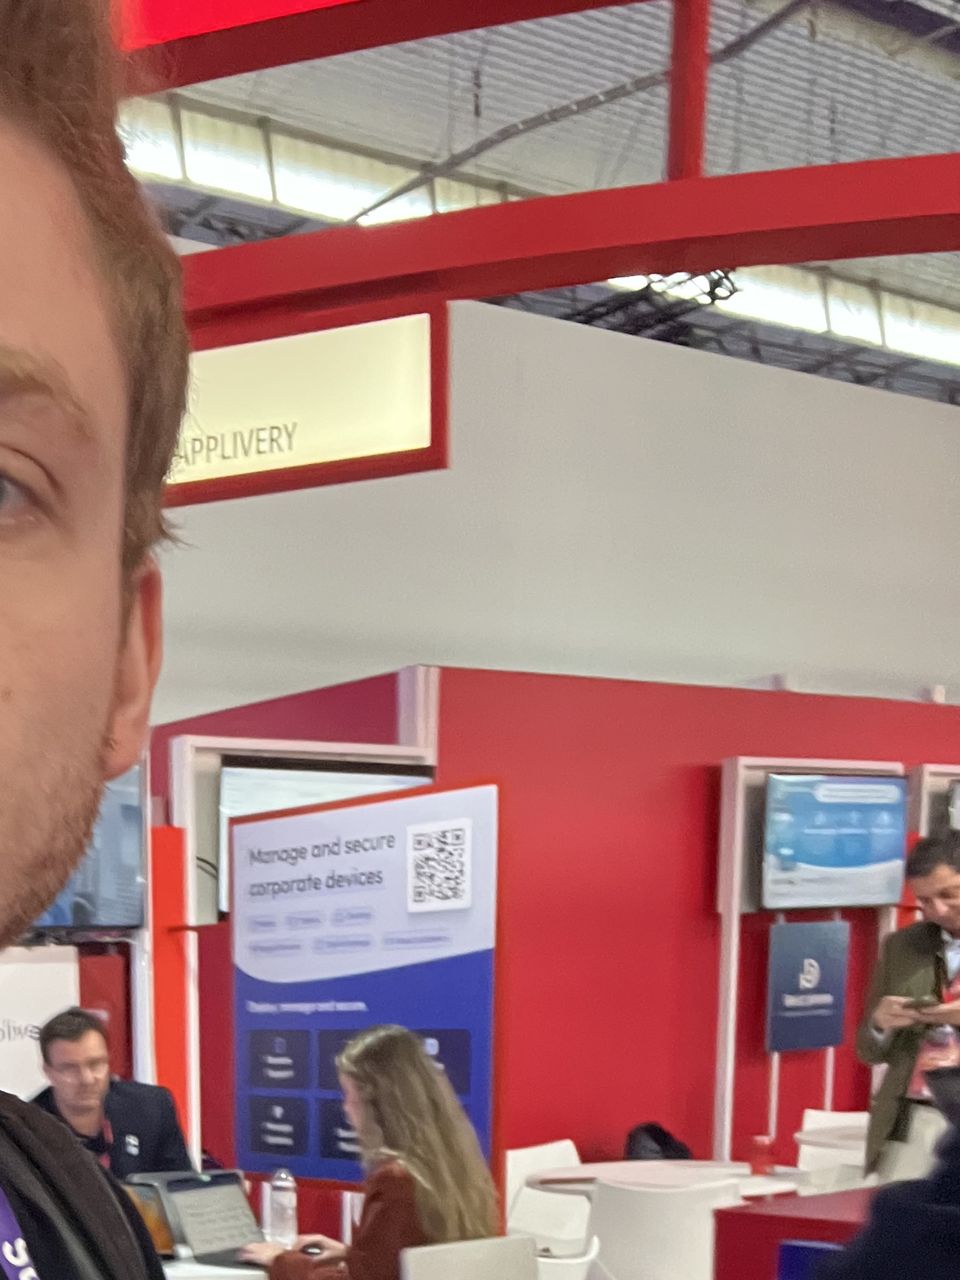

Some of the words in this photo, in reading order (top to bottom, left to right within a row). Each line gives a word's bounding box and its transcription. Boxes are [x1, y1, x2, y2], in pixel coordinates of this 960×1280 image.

[249, 845, 308, 866] Manage
[311, 836, 341, 858] and
[344, 834, 396, 854] secure
[249, 873, 322, 898] corporate
[325, 867, 383, 889] devices
